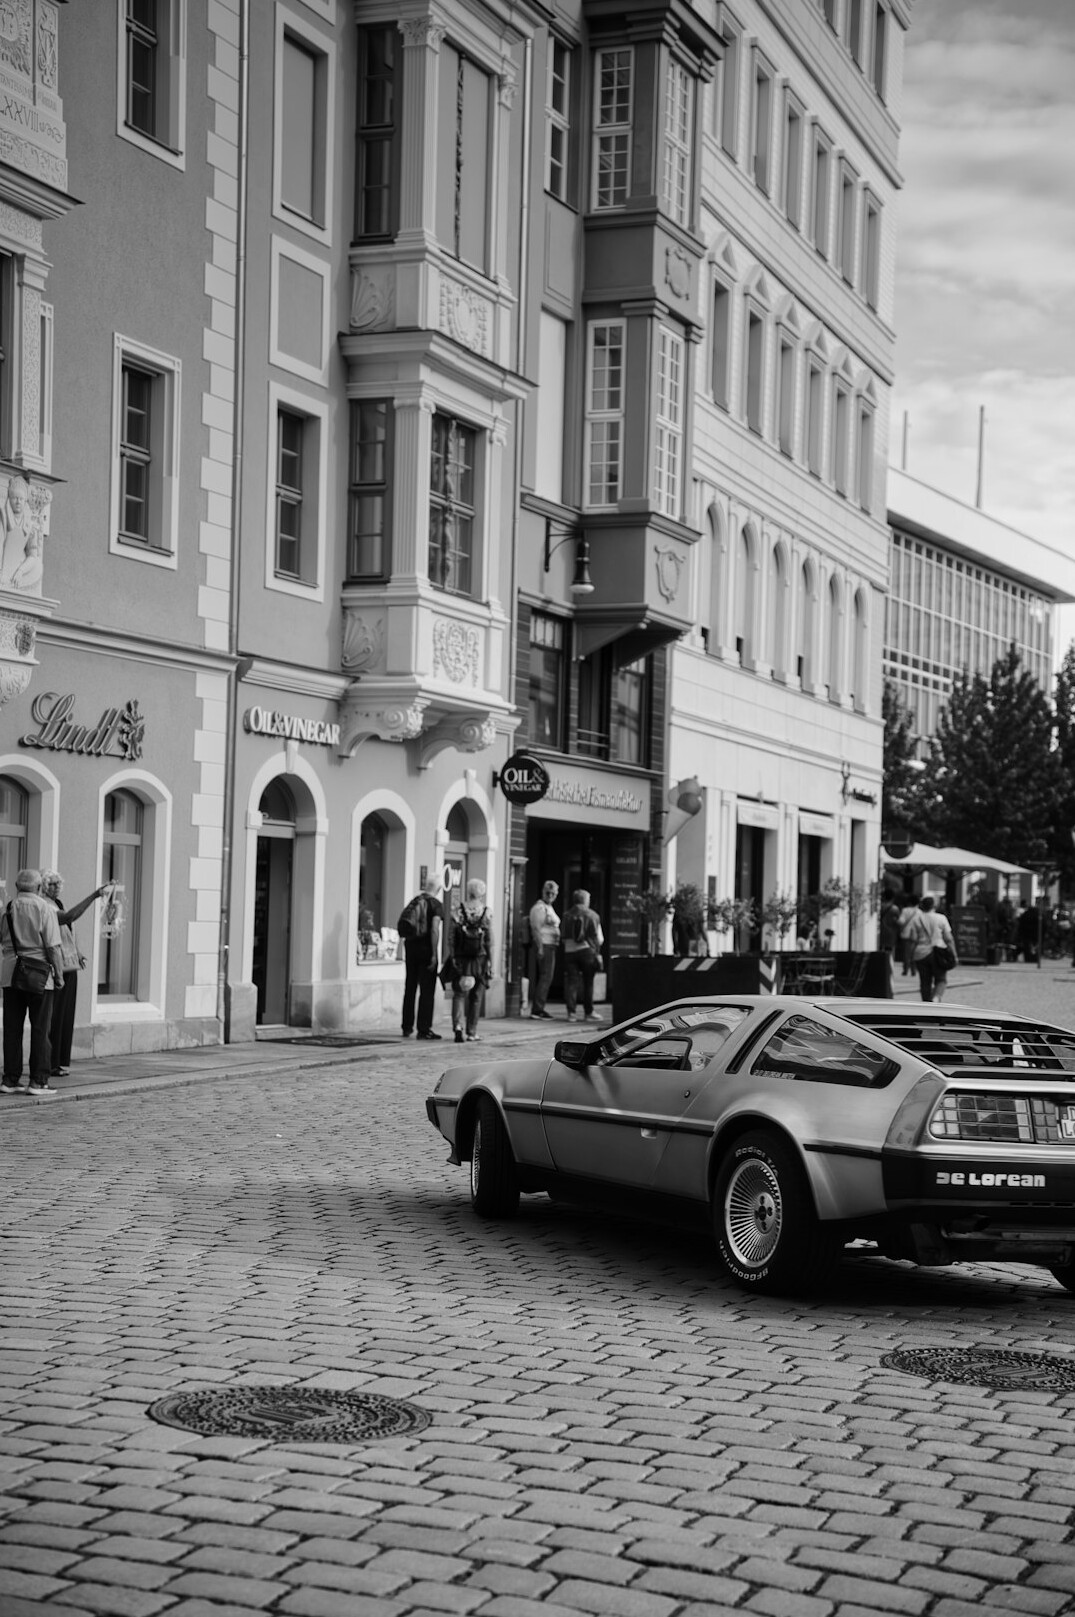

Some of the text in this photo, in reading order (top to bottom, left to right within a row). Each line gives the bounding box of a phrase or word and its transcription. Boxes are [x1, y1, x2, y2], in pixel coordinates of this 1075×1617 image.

[22, 691, 122, 756] Lindt
[505, 784, 542, 792] VINEGAR
[719, 1240, 769, 1281] BFGoodrich
